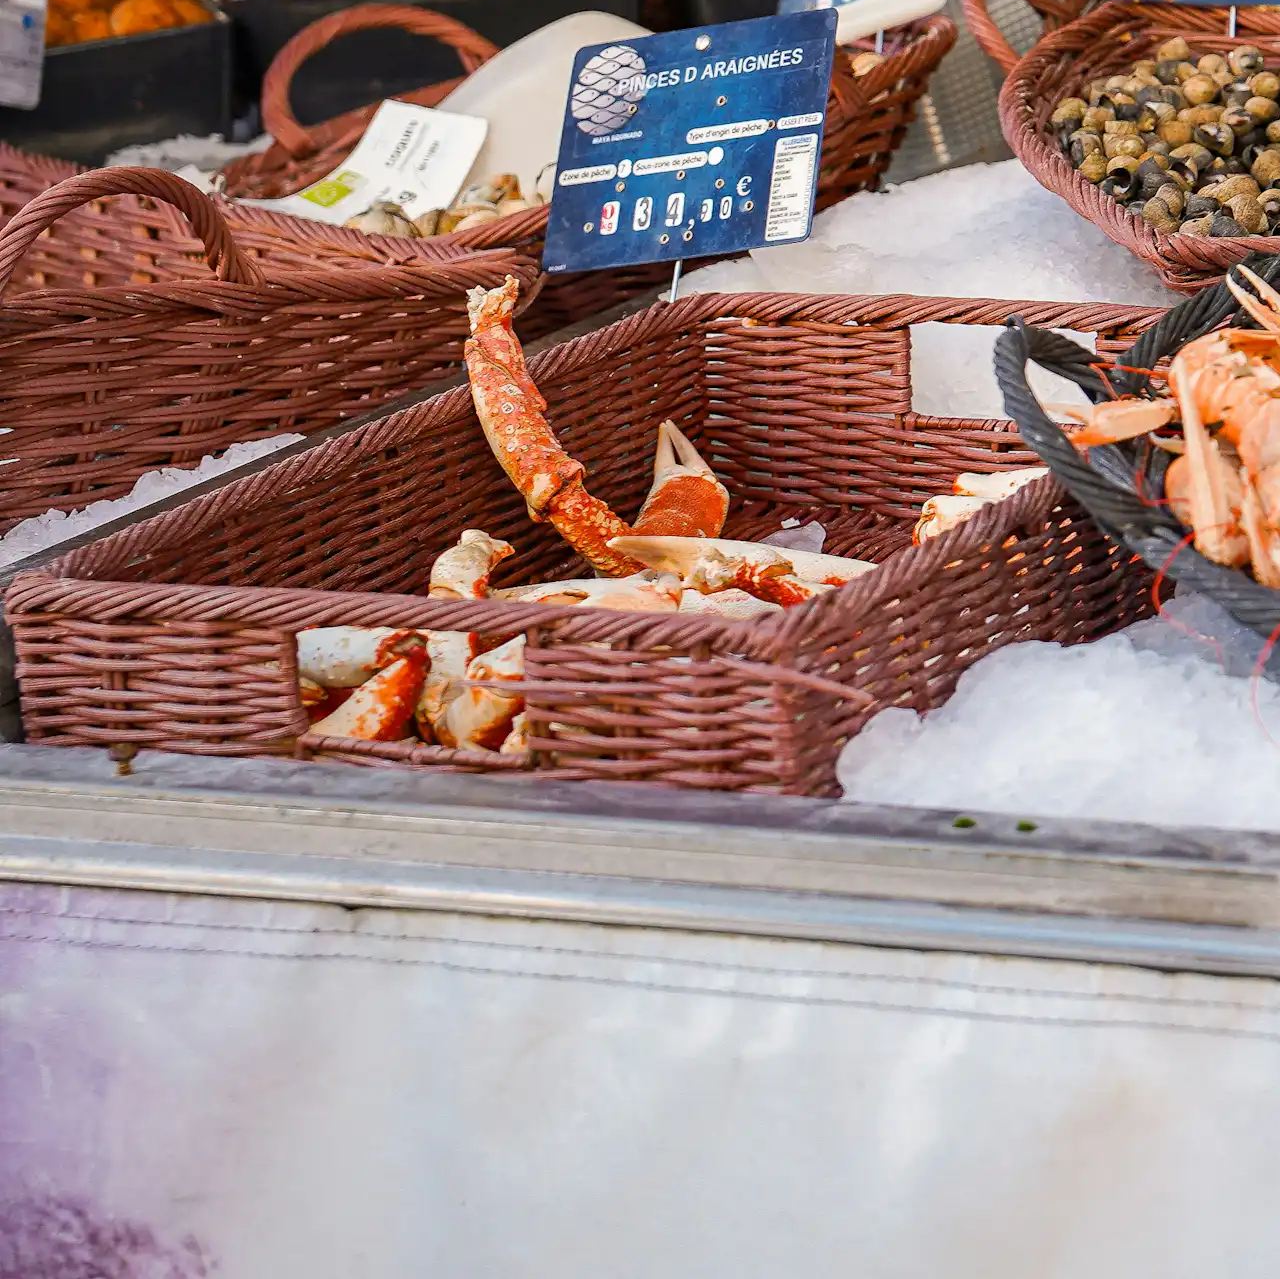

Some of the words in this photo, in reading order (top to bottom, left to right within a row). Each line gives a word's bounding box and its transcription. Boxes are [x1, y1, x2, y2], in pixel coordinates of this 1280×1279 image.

[617, 69, 681, 95] PINCES
[684, 66, 697, 82] D
[700, 48, 804, 81] ARAIGNÉES
[736, 175, 753, 197] €
[600, 221, 614, 232] kg
